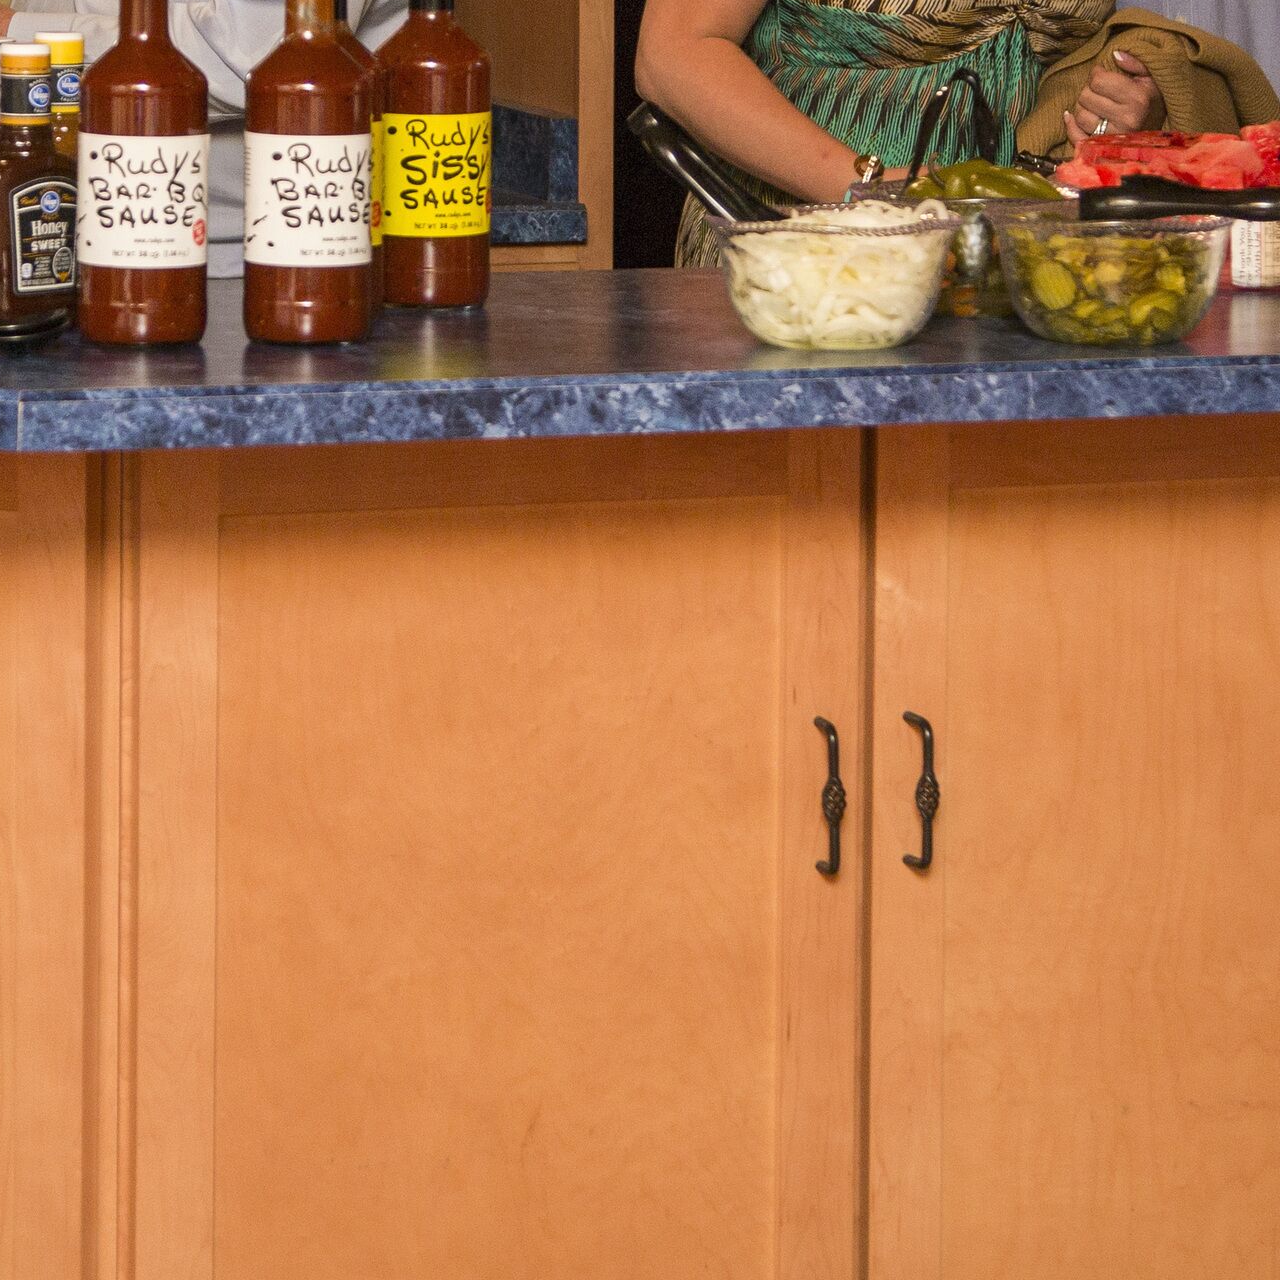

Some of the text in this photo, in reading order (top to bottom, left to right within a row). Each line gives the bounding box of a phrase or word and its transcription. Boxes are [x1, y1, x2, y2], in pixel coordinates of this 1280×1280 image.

[399, 186, 487, 210] SAUSE
[96, 204, 197, 228] SAUSE
[31, 220, 68, 237] Honey
[30, 238, 67, 254] SWEET
